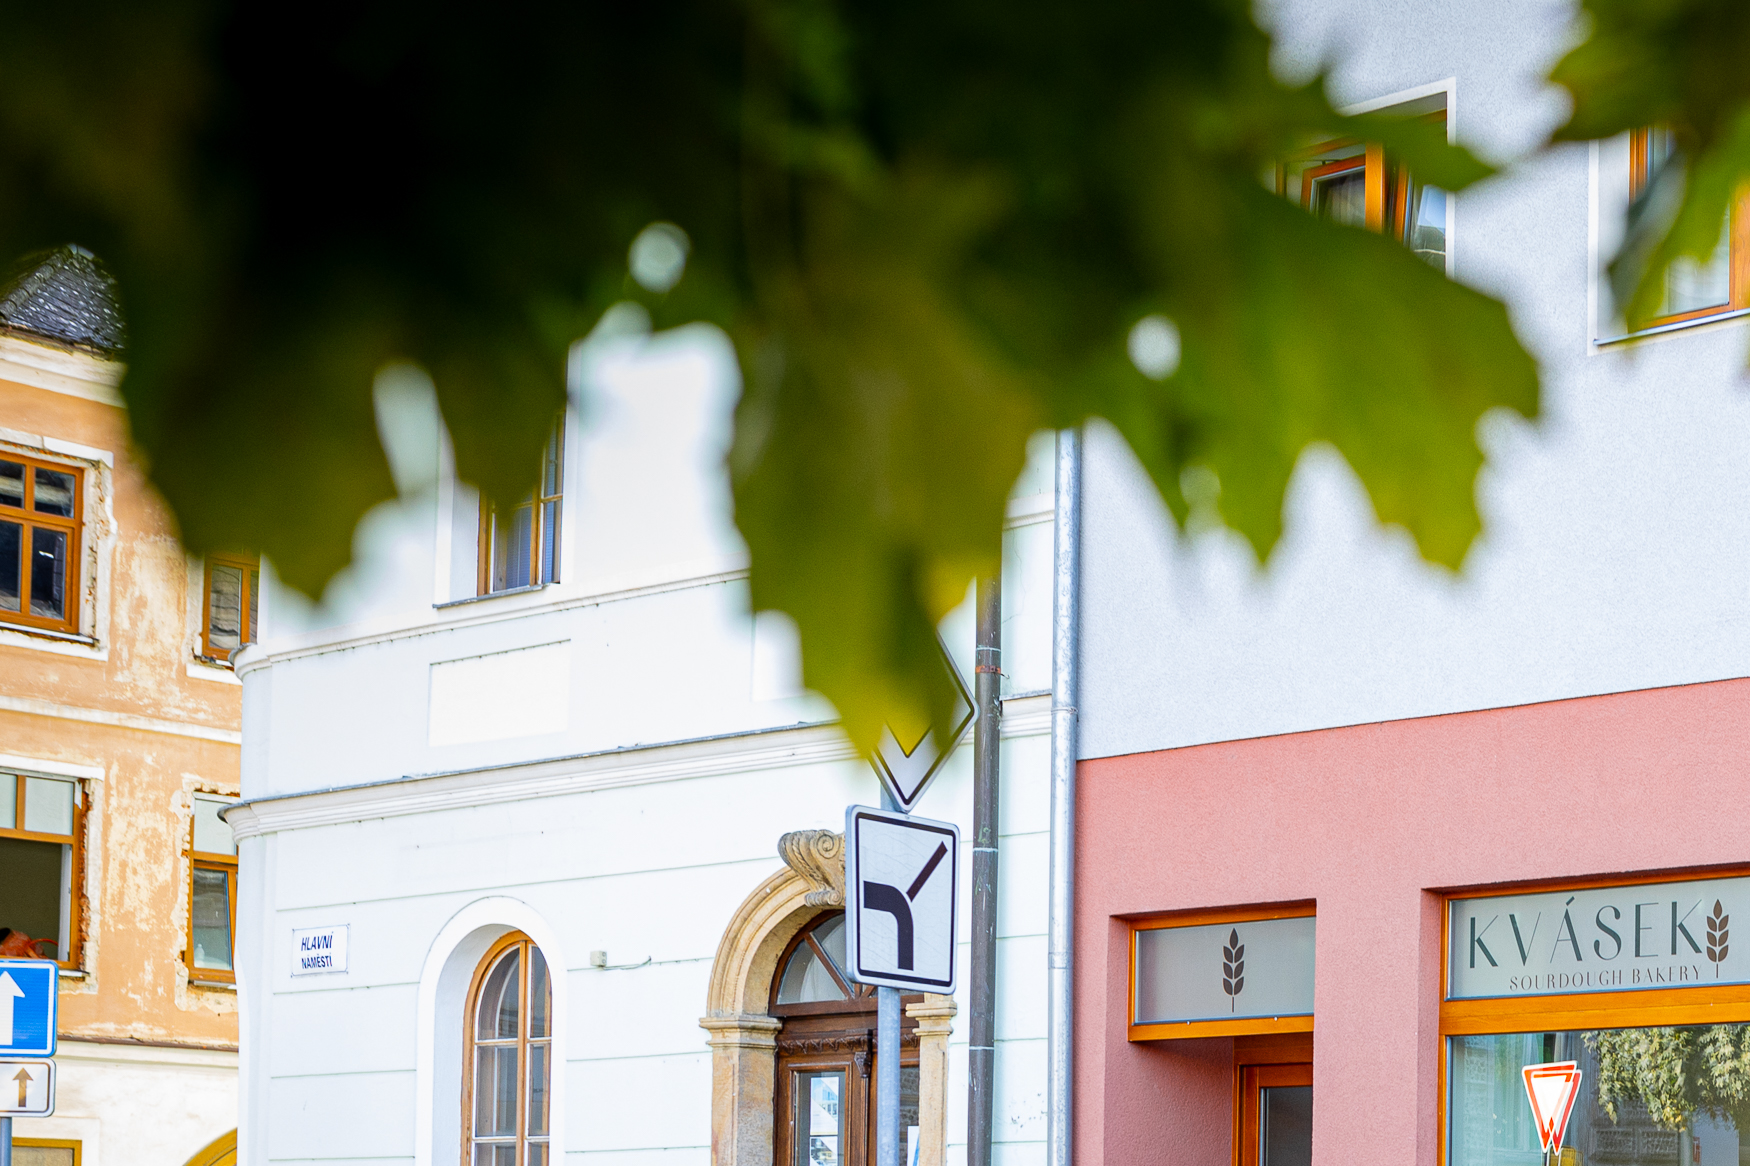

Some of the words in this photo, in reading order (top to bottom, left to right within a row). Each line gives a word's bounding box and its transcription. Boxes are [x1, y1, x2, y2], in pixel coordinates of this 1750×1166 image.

[301, 931, 333, 951] HLAVNÍ
[1469, 896, 1703, 969] KVÁSEK
[301, 952, 333, 969] NÁMĚSTÍ
[1509, 968, 1623, 991] SOURDOUGH
[1632, 963, 1703, 985] BAKERY
